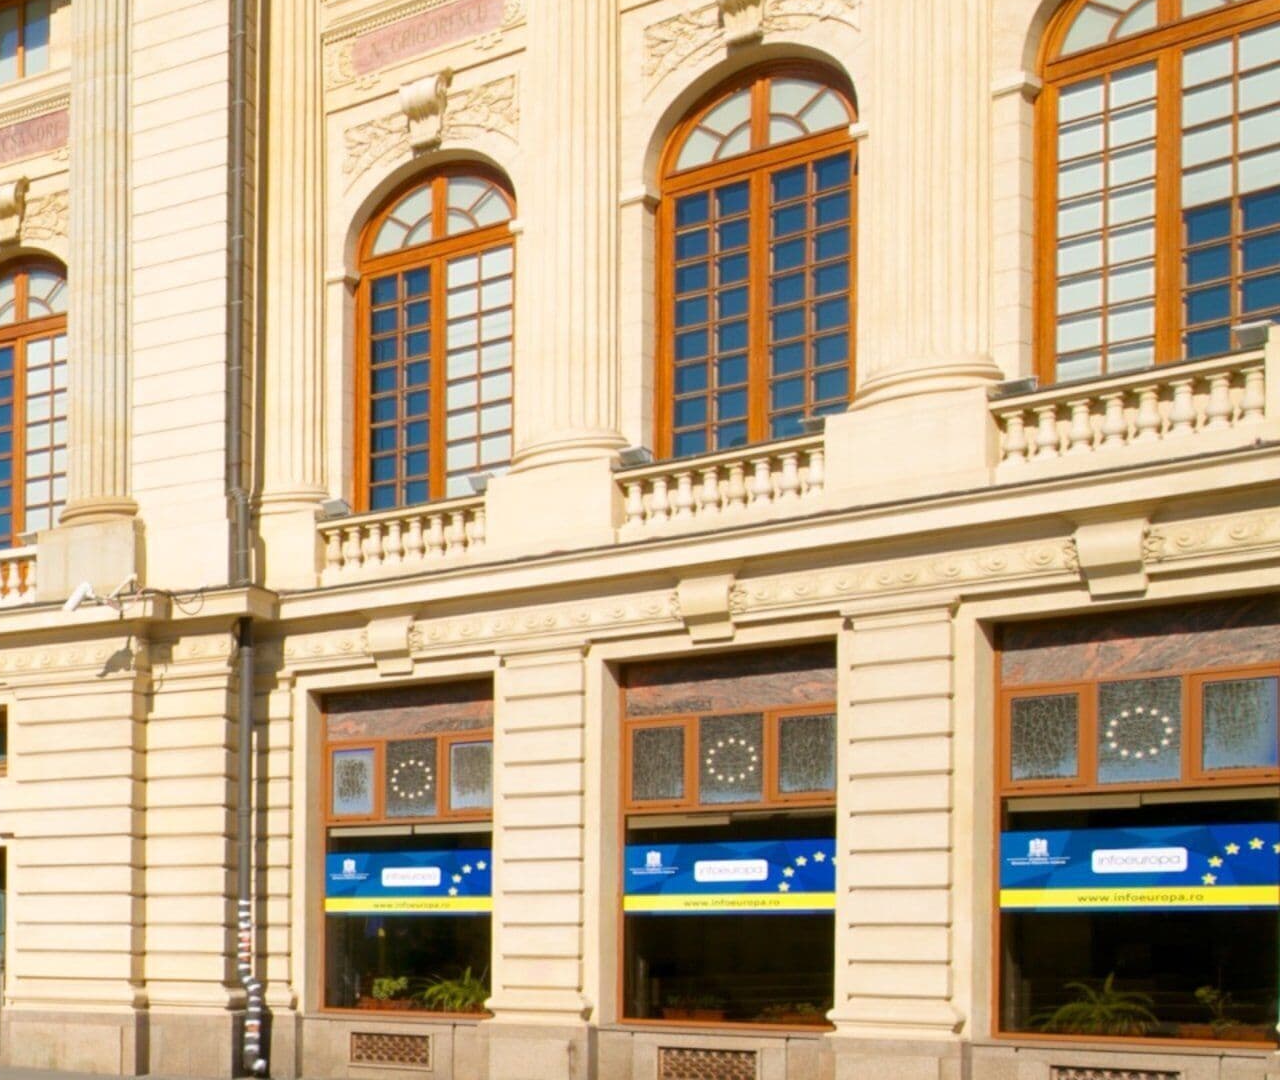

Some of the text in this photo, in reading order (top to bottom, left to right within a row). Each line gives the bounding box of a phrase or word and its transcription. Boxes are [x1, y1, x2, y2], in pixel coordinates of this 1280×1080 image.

[1097, 853, 1182, 867] infoeuropa
[684, 898, 781, 907] www.infoeuropa.ro
[1077, 892, 1205, 903] www.infoeuropa.ro
